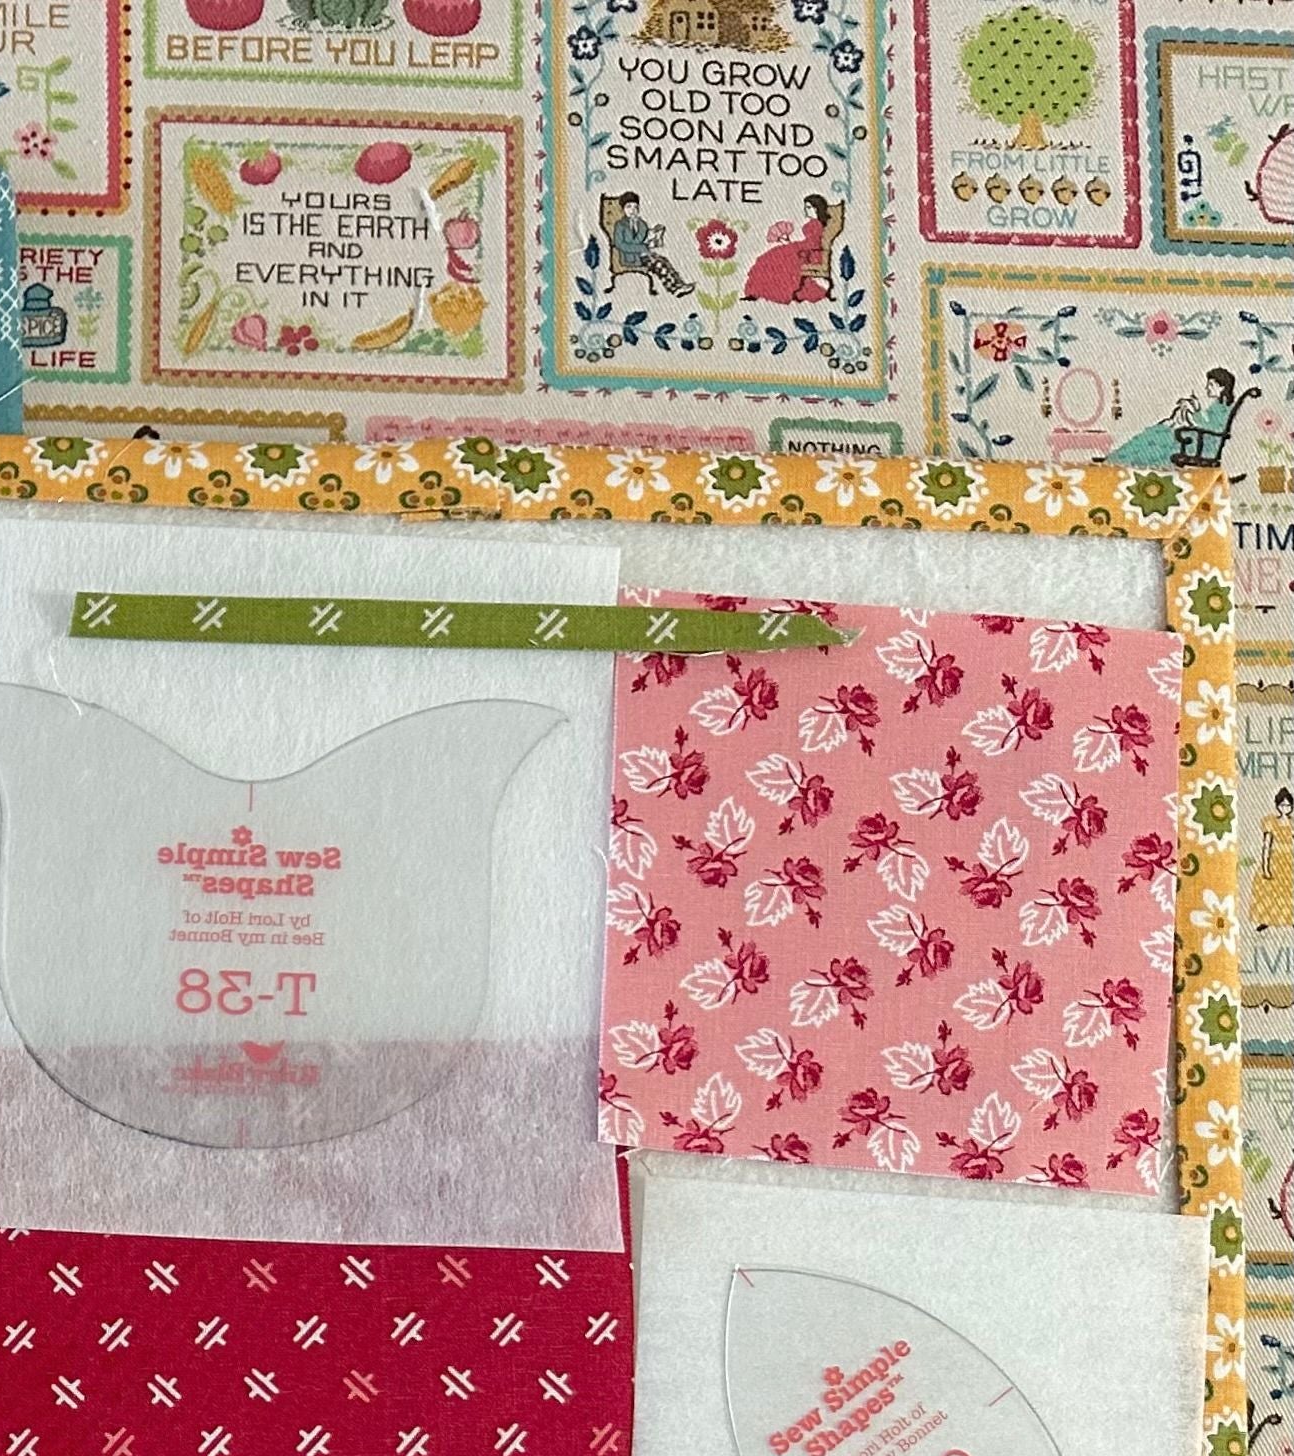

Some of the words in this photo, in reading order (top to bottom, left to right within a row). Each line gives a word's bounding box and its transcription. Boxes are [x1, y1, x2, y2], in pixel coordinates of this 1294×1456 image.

[167, 36, 312, 64] BEFORE
[326, 39, 395, 66] YOU
[409, 42, 499, 68] LEAP
[618, 57, 690, 87] YOU
[702, 60, 812, 92] GROW
[641, 88, 712, 115] OLD
[724, 90, 791, 118] TOO
[620, 115, 727, 144] SOON
[737, 118, 815, 148] AND
[607, 145, 746, 174] SMART
[756, 148, 828, 178] TOO
[280, 192, 391, 211] YOURS
[672, 179, 763, 204] LATE
[242, 214, 263, 236] IS
[272, 214, 322, 237] THE
[337, 215, 429, 240] EARTH
[309, 242, 363, 259] AND
[36, 266, 93, 283] THE
[237, 263, 435, 288] EVERYTHING
[302, 291, 333, 308] IN
[343, 292, 369, 309] IT
[31, 351, 96, 368] LIFE
[768, 1407, 823, 1456] Sew
[822, 1339, 911, 1413] Simple
[879, 1417, 910, 1448] Holt
[912, 1403, 927, 1420] of
[899, 1410, 948, 1454] Bonnet
